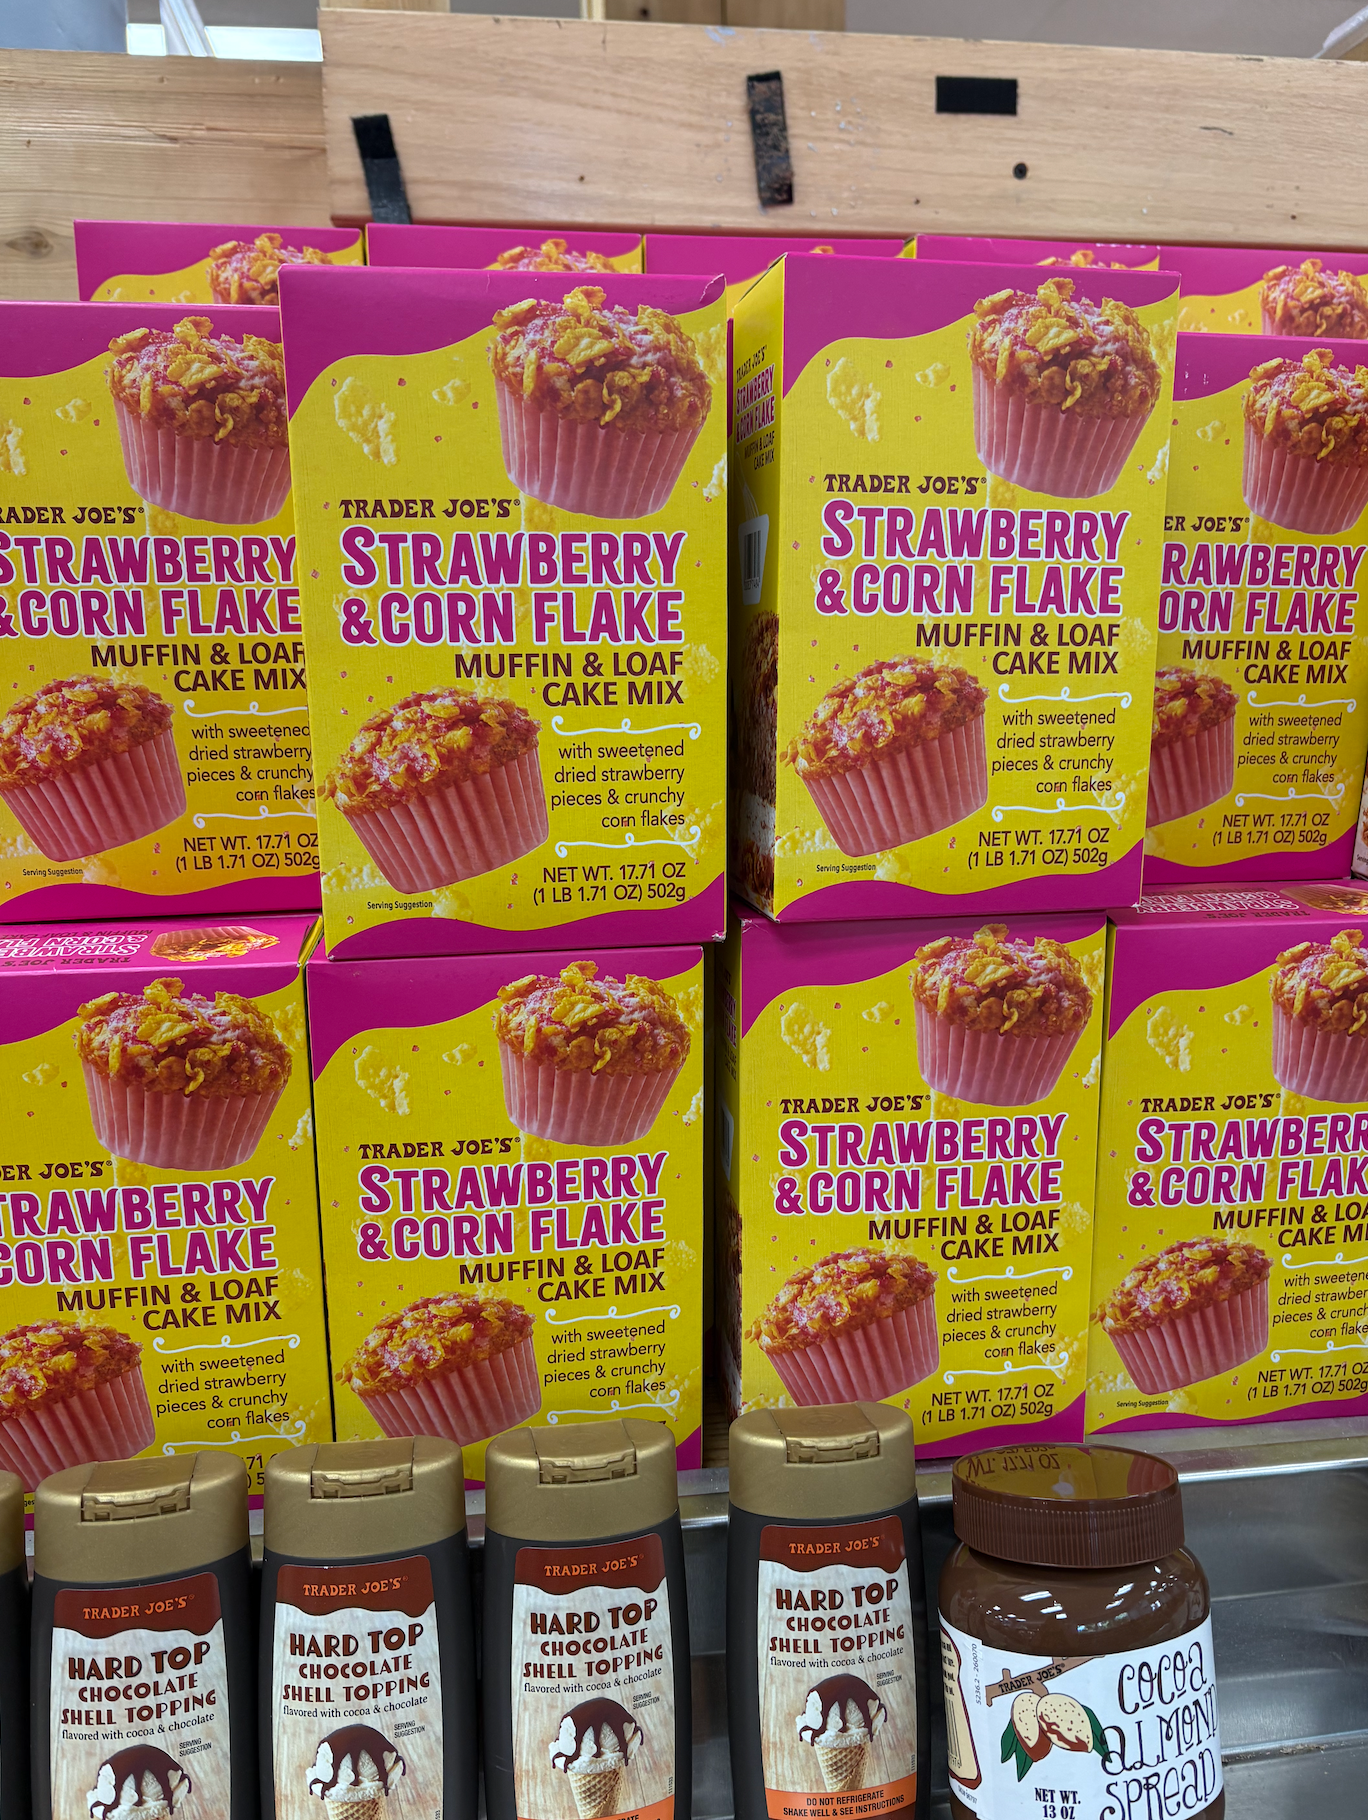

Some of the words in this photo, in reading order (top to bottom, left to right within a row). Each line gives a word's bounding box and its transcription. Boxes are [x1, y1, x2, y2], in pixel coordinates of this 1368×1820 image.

[823, 475, 909, 492] TRADER
[339, 500, 435, 518] TRADER
[821, 498, 1131, 561] STRAWBERRY
[341, 525, 687, 587] STRAWBERRY
[532, 590, 684, 644] FLAKE
[916, 624, 1021, 647] MUFFIN
[1030, 623, 1049, 646] &
[1057, 624, 1120, 647] LOAF
[1182, 640, 1270, 660] MUFFIN
[1276, 640, 1292, 660] &
[1298, 641, 1352, 661] LOAF
[455, 653, 571, 678] MUFFIN
[583, 652, 604, 676] &
[614, 652, 683, 676] LOAF
[993, 652, 1059, 675] CAKE
[1069, 652, 1118, 674] MIX
[1244, 665, 1299, 684] CAKE
[1306, 665, 1349, 684] MIX
[175, 670, 245, 692] CAKE
[254, 669, 307, 690] MIX
[543, 682, 617, 706] CAKE
[628, 681, 684, 704] MIX
[1003, 711, 1032, 726] with
[1038, 708, 1115, 726] sweetened
[559, 743, 592, 759] with
[598, 739, 683, 758] sweetened
[997, 732, 1034, 748] dried
[1040, 731, 1114, 751] strawberry
[555, 765, 595, 782] dried
[602, 764, 684, 784] strawberry
[237, 791, 268, 801] corn
[273, 785, 314, 800] flakes
[552, 791, 601, 810] pieces
[608, 789, 619, 804] &
[625, 787, 684, 807] crunchy
[602, 816, 635, 827] corn
[641, 810, 684, 826] flakes
[1223, 814, 1250, 827] NET
[1253, 814, 1275, 826] WT.
[1281, 813, 1307, 826] 17.71
[1312, 813, 1330, 825] OZ
[22, 868, 47, 877] Serving
[47, 867, 84, 877] Suggestion
[544, 867, 578, 882] NET
[582, 866, 613, 881] WT.
[620, 863, 654, 879] 17.71
[663, 863, 685, 878] OZ
[816, 863, 840, 874] Serving
[841, 862, 876, 873] Suggestion
[368, 902, 393, 910] Serving
[395, 901, 432, 910] Suggestion
[553, 887, 571, 902] LB
[578, 886, 606, 901] 1.71
[614, 884, 642, 901] OZ)
[648, 883, 686, 906] 502g
[1140, 1096, 1213, 1113] TRADER
[778, 1113, 1068, 1170] STRAWBERRY
[359, 1152, 669, 1216] STRAWBERRY
[868, 1215, 966, 1240] MUFFIN
[975, 1214, 993, 1234] &
[1001, 1211, 1060, 1233] LOAF
[940, 1237, 1003, 1259] CAKE
[1012, 1234, 1059, 1255] MIX
[460, 1257, 564, 1283] MUFFIN
[574, 1255, 593, 1275] &
[602, 1250, 664, 1273] LOAF
[57, 1284, 170, 1312] MUFFIN
[181, 1282, 202, 1303] &
[210, 1277, 277, 1301] LOAF
[943, 1329, 985, 1345] pieces
[991, 1325, 1001, 1338] &
[1006, 1322, 1056, 1338] crunchy
[1116, 1399, 1138, 1409] Serving
[1138, 1397, 1169, 1408] Suggestion
[788, 1542, 841, 1554] TRADER
[544, 1564, 598, 1577] TRADER
[303, 1583, 357, 1597] TRADER
[775, 1588, 843, 1612] HARD
[850, 1578, 899, 1608] TOP
[82, 1605, 140, 1620] TRADER
[530, 1611, 600, 1635] HARD
[607, 1598, 658, 1627] TOP
[786, 1607, 890, 1632] CHOCOLATE
[289, 1632, 359, 1658] HARD
[367, 1622, 424, 1654] TOP
[540, 1627, 649, 1656] CHOCOLATE
[769, 1636, 822, 1654] SHELL
[830, 1624, 905, 1653] TOPPING
[68, 1655, 142, 1681] HARD
[150, 1640, 211, 1674] TOP
[299, 1653, 413, 1680] CHOCOLATE
[523, 1662, 577, 1678] SHELL
[587, 1644, 663, 1677] TOPPING
[770, 1655, 806, 1669] flavored
[809, 1657, 829, 1668] with
[831, 1657, 856, 1668] cocoa
[858, 1655, 865, 1665] &
[867, 1646, 904, 1662] chocolate
[78, 1672, 199, 1703] CHOCOLATE
[282, 1684, 335, 1703] SHELL
[342, 1672, 430, 1702] TOPPING
[524, 1682, 561, 1694] flavored
[563, 1682, 584, 1693] with
[586, 1681, 612, 1692] cocoa
[613, 1677, 621, 1686] &
[623, 1667, 662, 1685] chocolate
[998, 1675, 1035, 1693] TRADER
[61, 1708, 116, 1726] SHELL
[124, 1689, 217, 1723] TOPPING
[61, 1729, 99, 1741] flavored
[101, 1729, 124, 1740] with
[126, 1728, 155, 1739] cocoa
[157, 1724, 165, 1733] &
[168, 1712, 215, 1731] chocolate
[783, 1807, 808, 1817] SHAKE
[809, 1807, 830, 1817] WELL
[832, 1808, 838, 1816] &
[840, 1806, 854, 1816] SEE
[855, 1794, 905, 1814] INSTRUCTIONS
[806, 1798, 817, 1807] DO
[819, 1797, 834, 1806] NOT
[836, 1790, 884, 1805] REFRIGERATE
[1034, 1787, 1056, 1803] NET
[1059, 1790, 1081, 1805] WT.
[1042, 1804, 1057, 1819] 13
[1060, 1805, 1076, 1820] OZ
